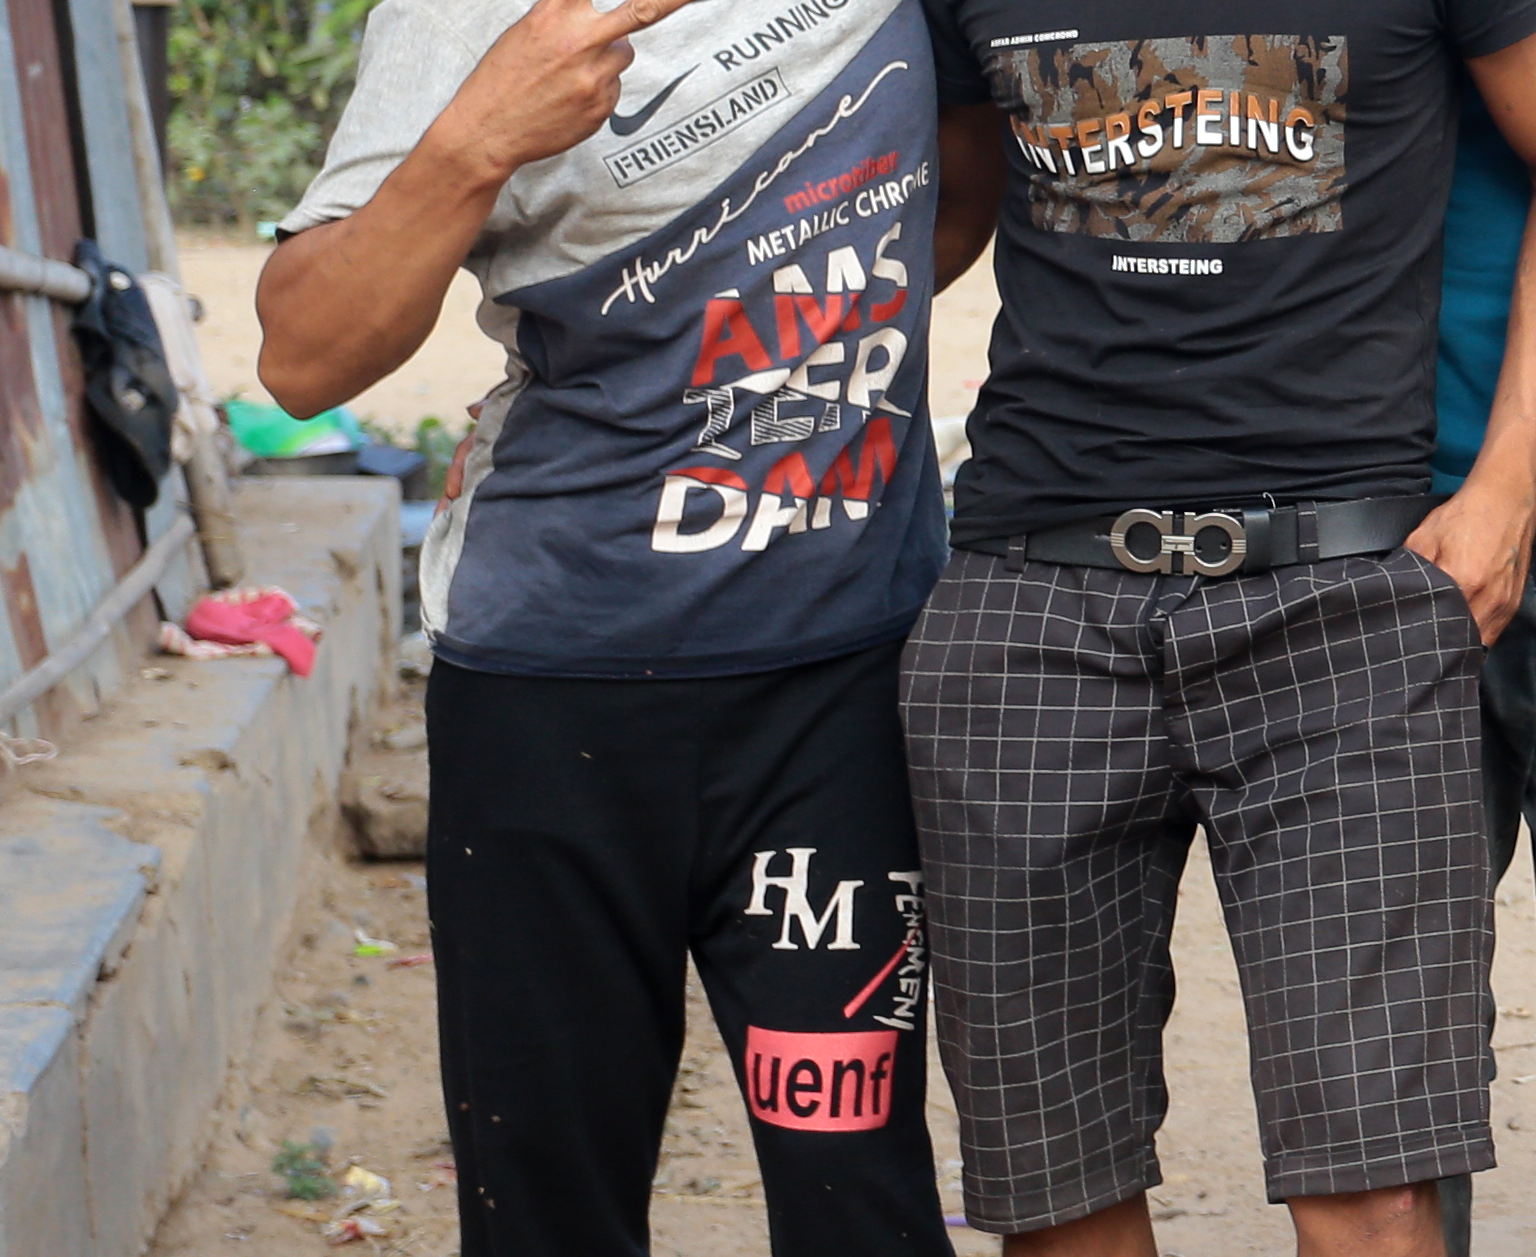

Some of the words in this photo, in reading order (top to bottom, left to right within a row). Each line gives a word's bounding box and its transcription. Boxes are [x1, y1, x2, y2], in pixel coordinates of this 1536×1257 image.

[613, 78, 779, 180] FRIENSLAND
[1010, 89, 1315, 176] INTERSTEING
[602, 60, 908, 316] Hurricane
[747, 201, 850, 266] METALLIC
[691, 221, 908, 387] AMS
[1112, 254, 1223, 275] INTERSTEING
[651, 416, 898, 554] DAM
[753, 1052, 893, 1118] uenf
